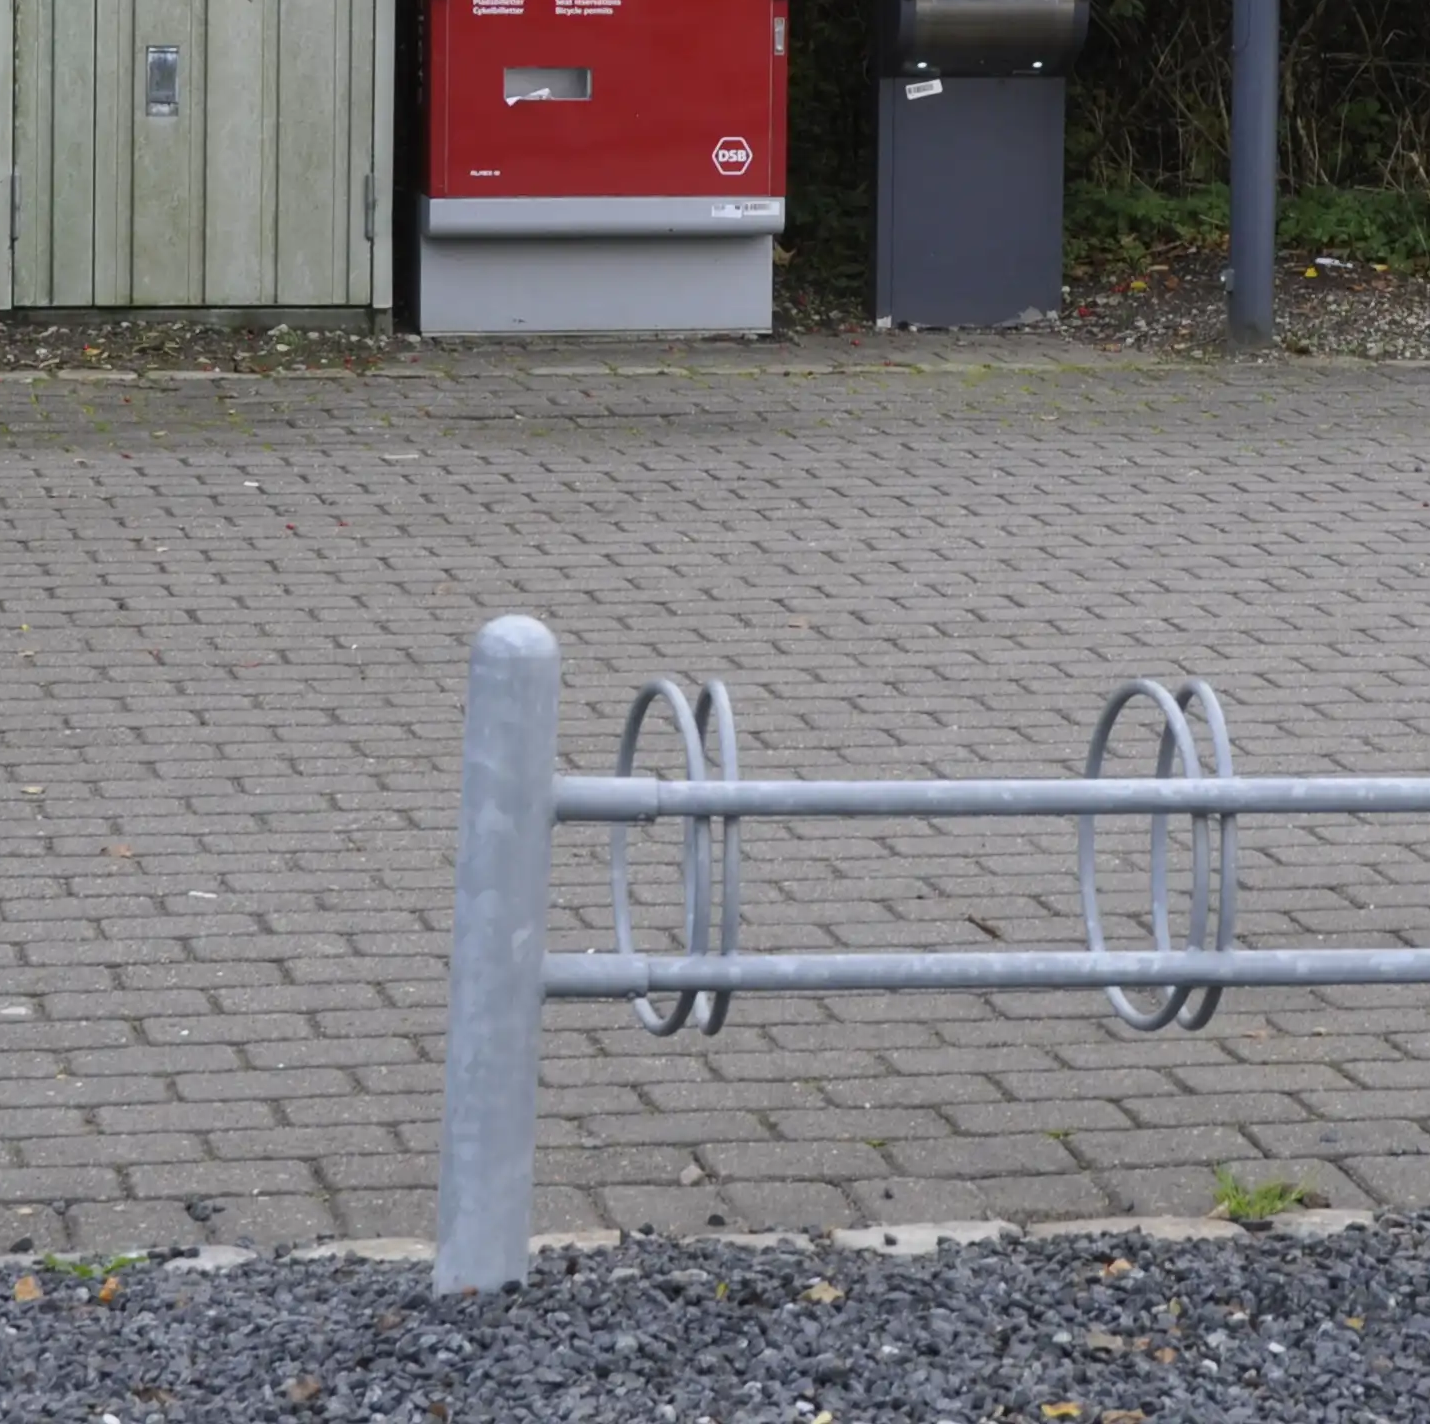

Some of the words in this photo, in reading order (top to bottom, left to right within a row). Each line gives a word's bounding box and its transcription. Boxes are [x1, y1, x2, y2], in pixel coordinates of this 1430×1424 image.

[555, 6, 582, 16] Bicycle
[583, 7, 613, 16] permits
[718, 150, 747, 162] DSB
